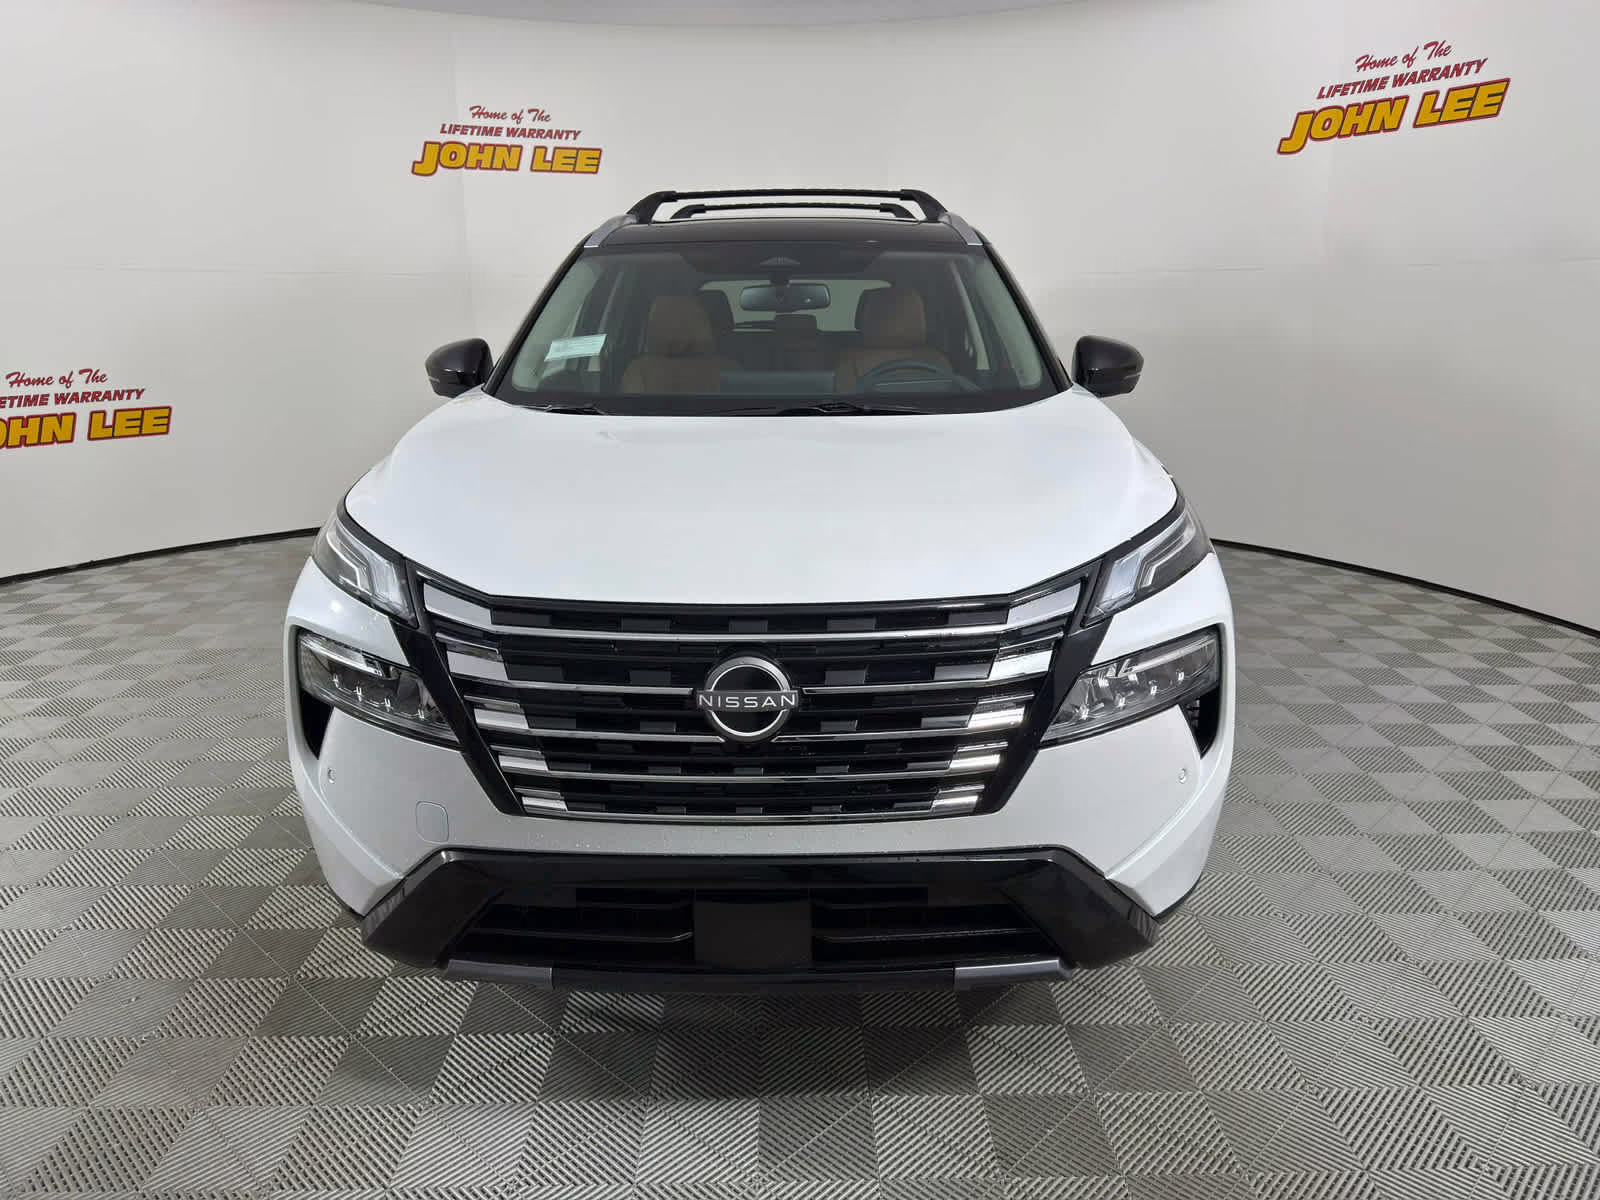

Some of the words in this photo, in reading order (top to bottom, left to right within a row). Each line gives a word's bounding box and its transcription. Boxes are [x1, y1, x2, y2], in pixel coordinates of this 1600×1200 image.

[1355, 54, 1398, 72] Home
[1401, 47, 1419, 67] of
[1423, 40, 1453, 60] The
[1316, 76, 1389, 99] LIFETIME
[1391, 57, 1488, 88] WARRANTY
[469, 105, 508, 120] Home
[511, 109, 524, 124] of
[527, 108, 552, 122] The
[1277, 95, 1410, 155] JOHN
[1412, 78, 1511, 128] LEE
[440, 123, 503, 137] LIFETIME
[505, 127, 581, 140] WARRANTY
[411, 141, 523, 176] JOHN
[530, 146, 602, 174] LEE
[5, 371, 54, 388] Home
[58, 370, 74, 389] of
[78, 368, 108, 384] The
[54, 388, 145, 405] WARRANTY
[87, 406, 172, 441] LEE
[699, 694, 795, 708] NISSAN
